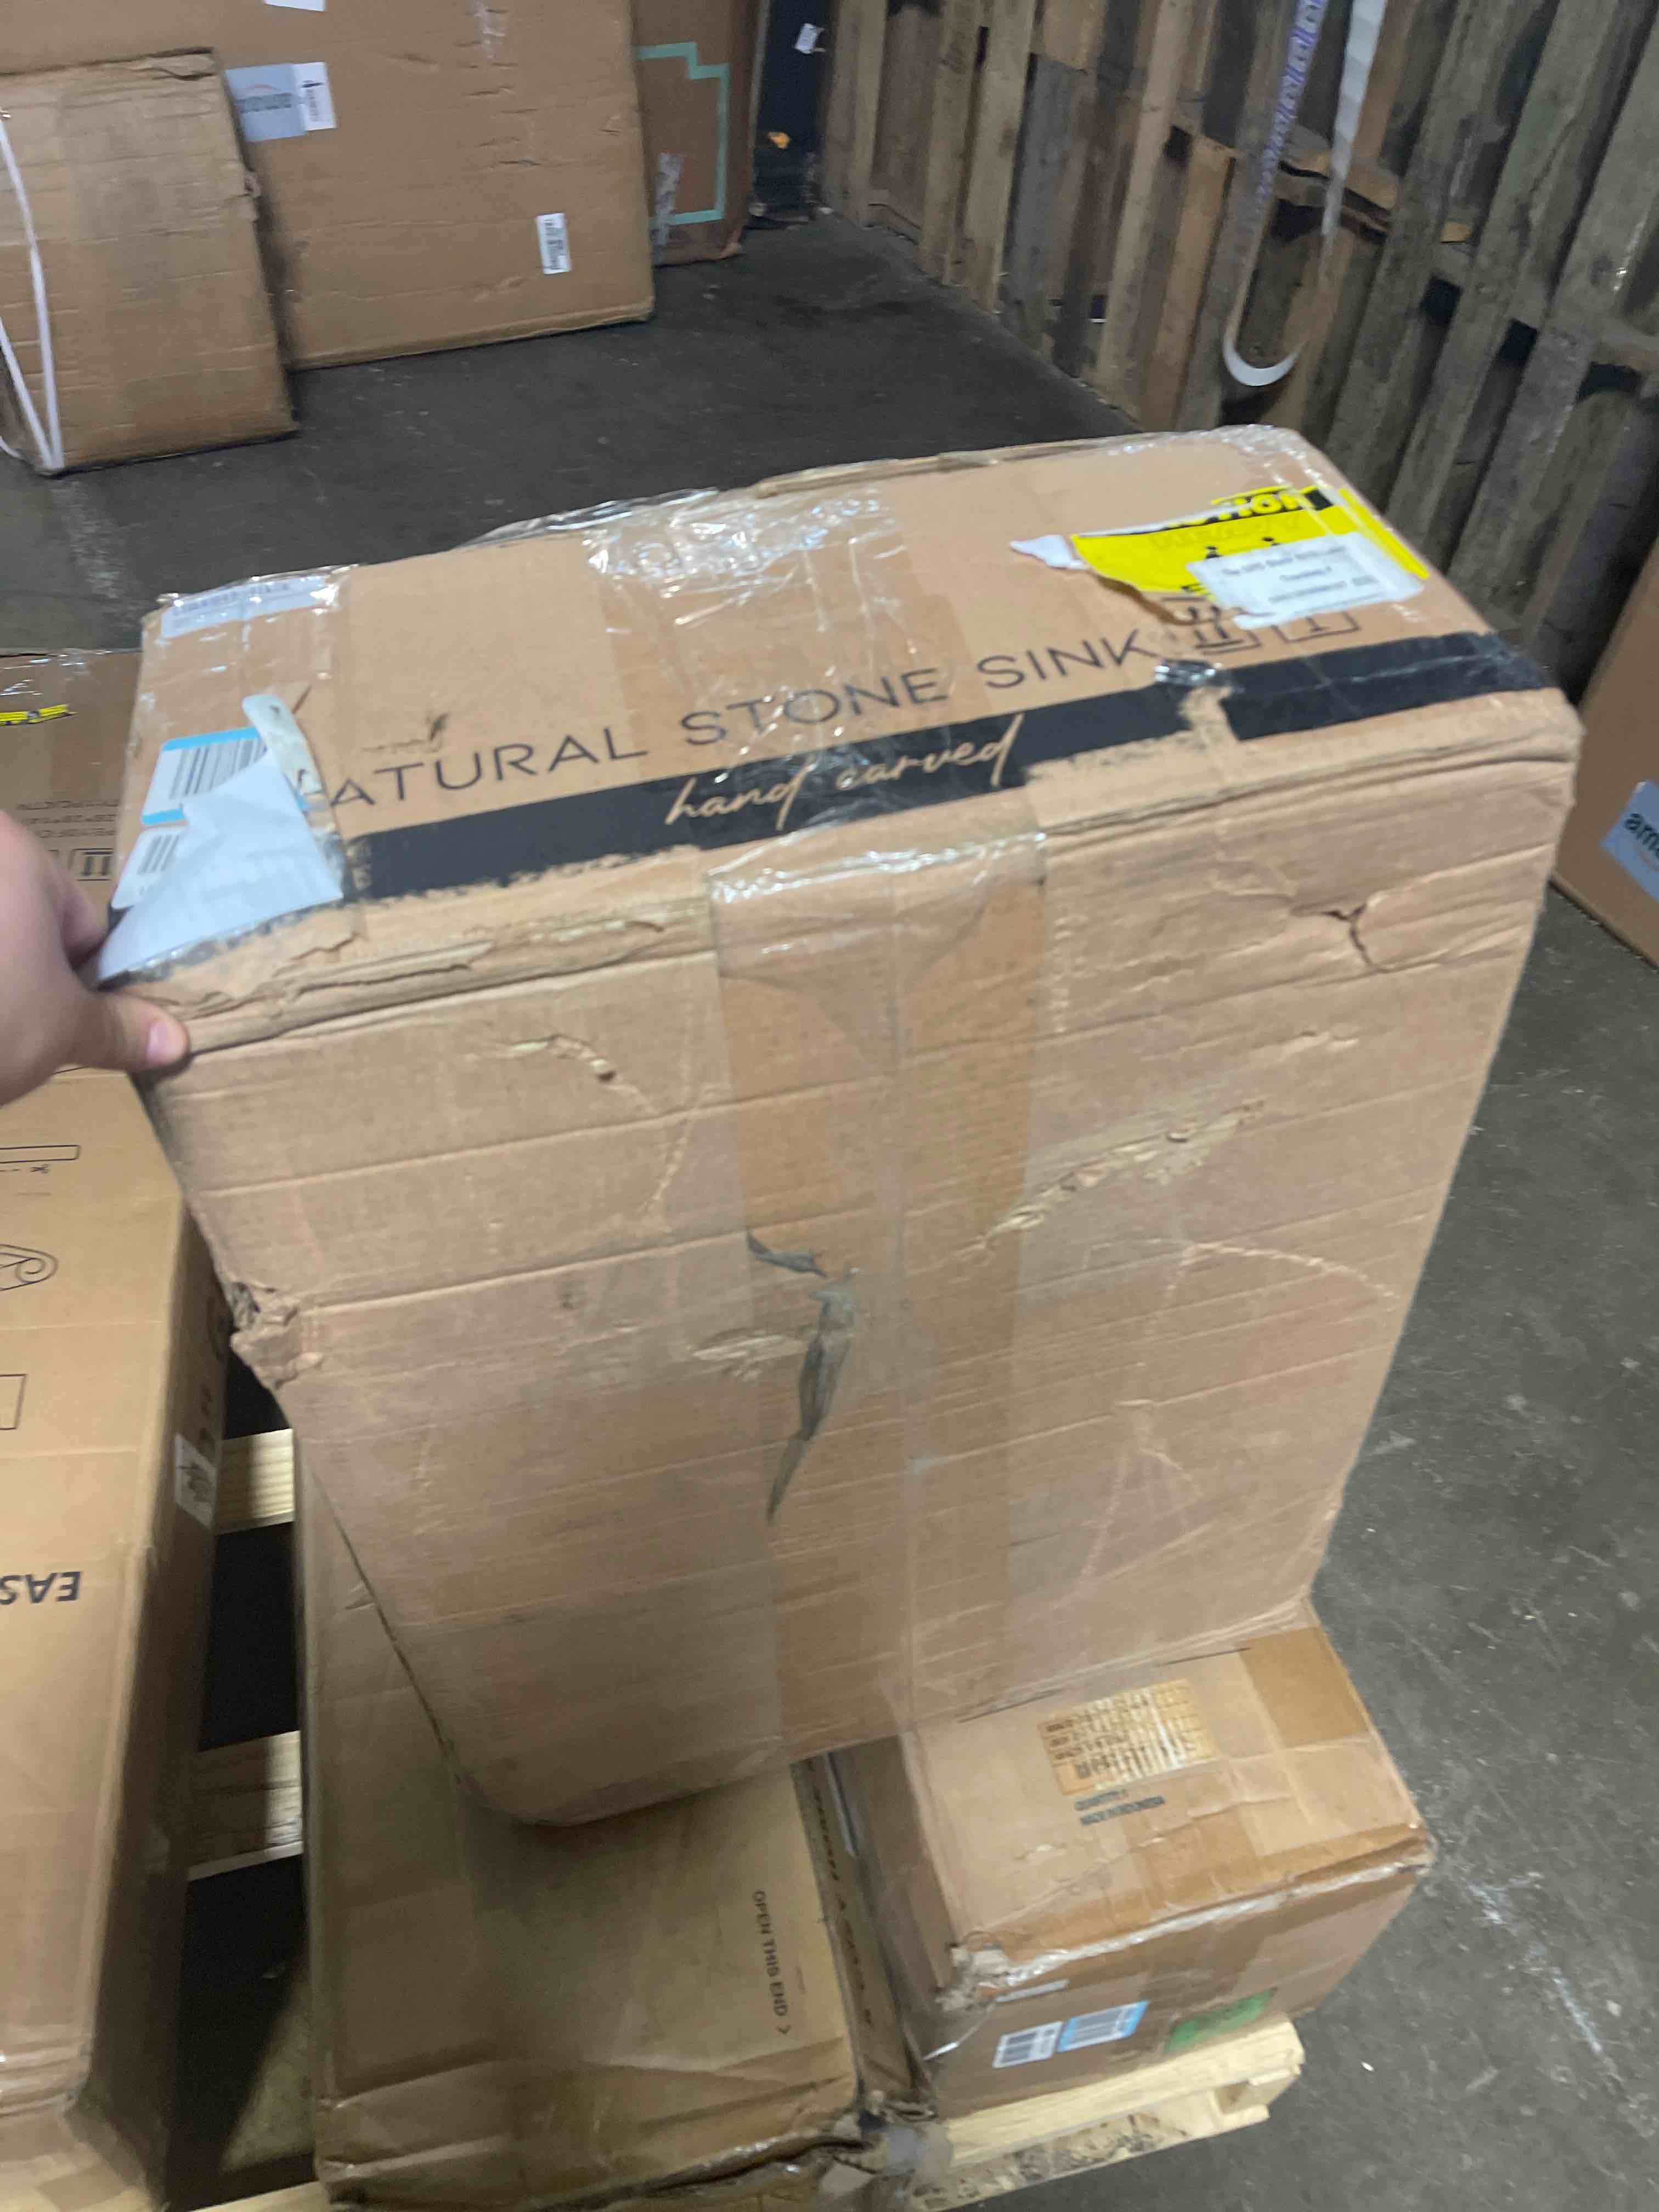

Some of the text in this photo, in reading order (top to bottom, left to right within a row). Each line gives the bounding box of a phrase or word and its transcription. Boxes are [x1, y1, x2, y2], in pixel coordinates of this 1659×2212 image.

[330, 629, 1159, 807] ATURAL STONE SINK
[664, 713, 1024, 830] hand carved
[753, 1891, 788, 2016] OPEN THIS END
